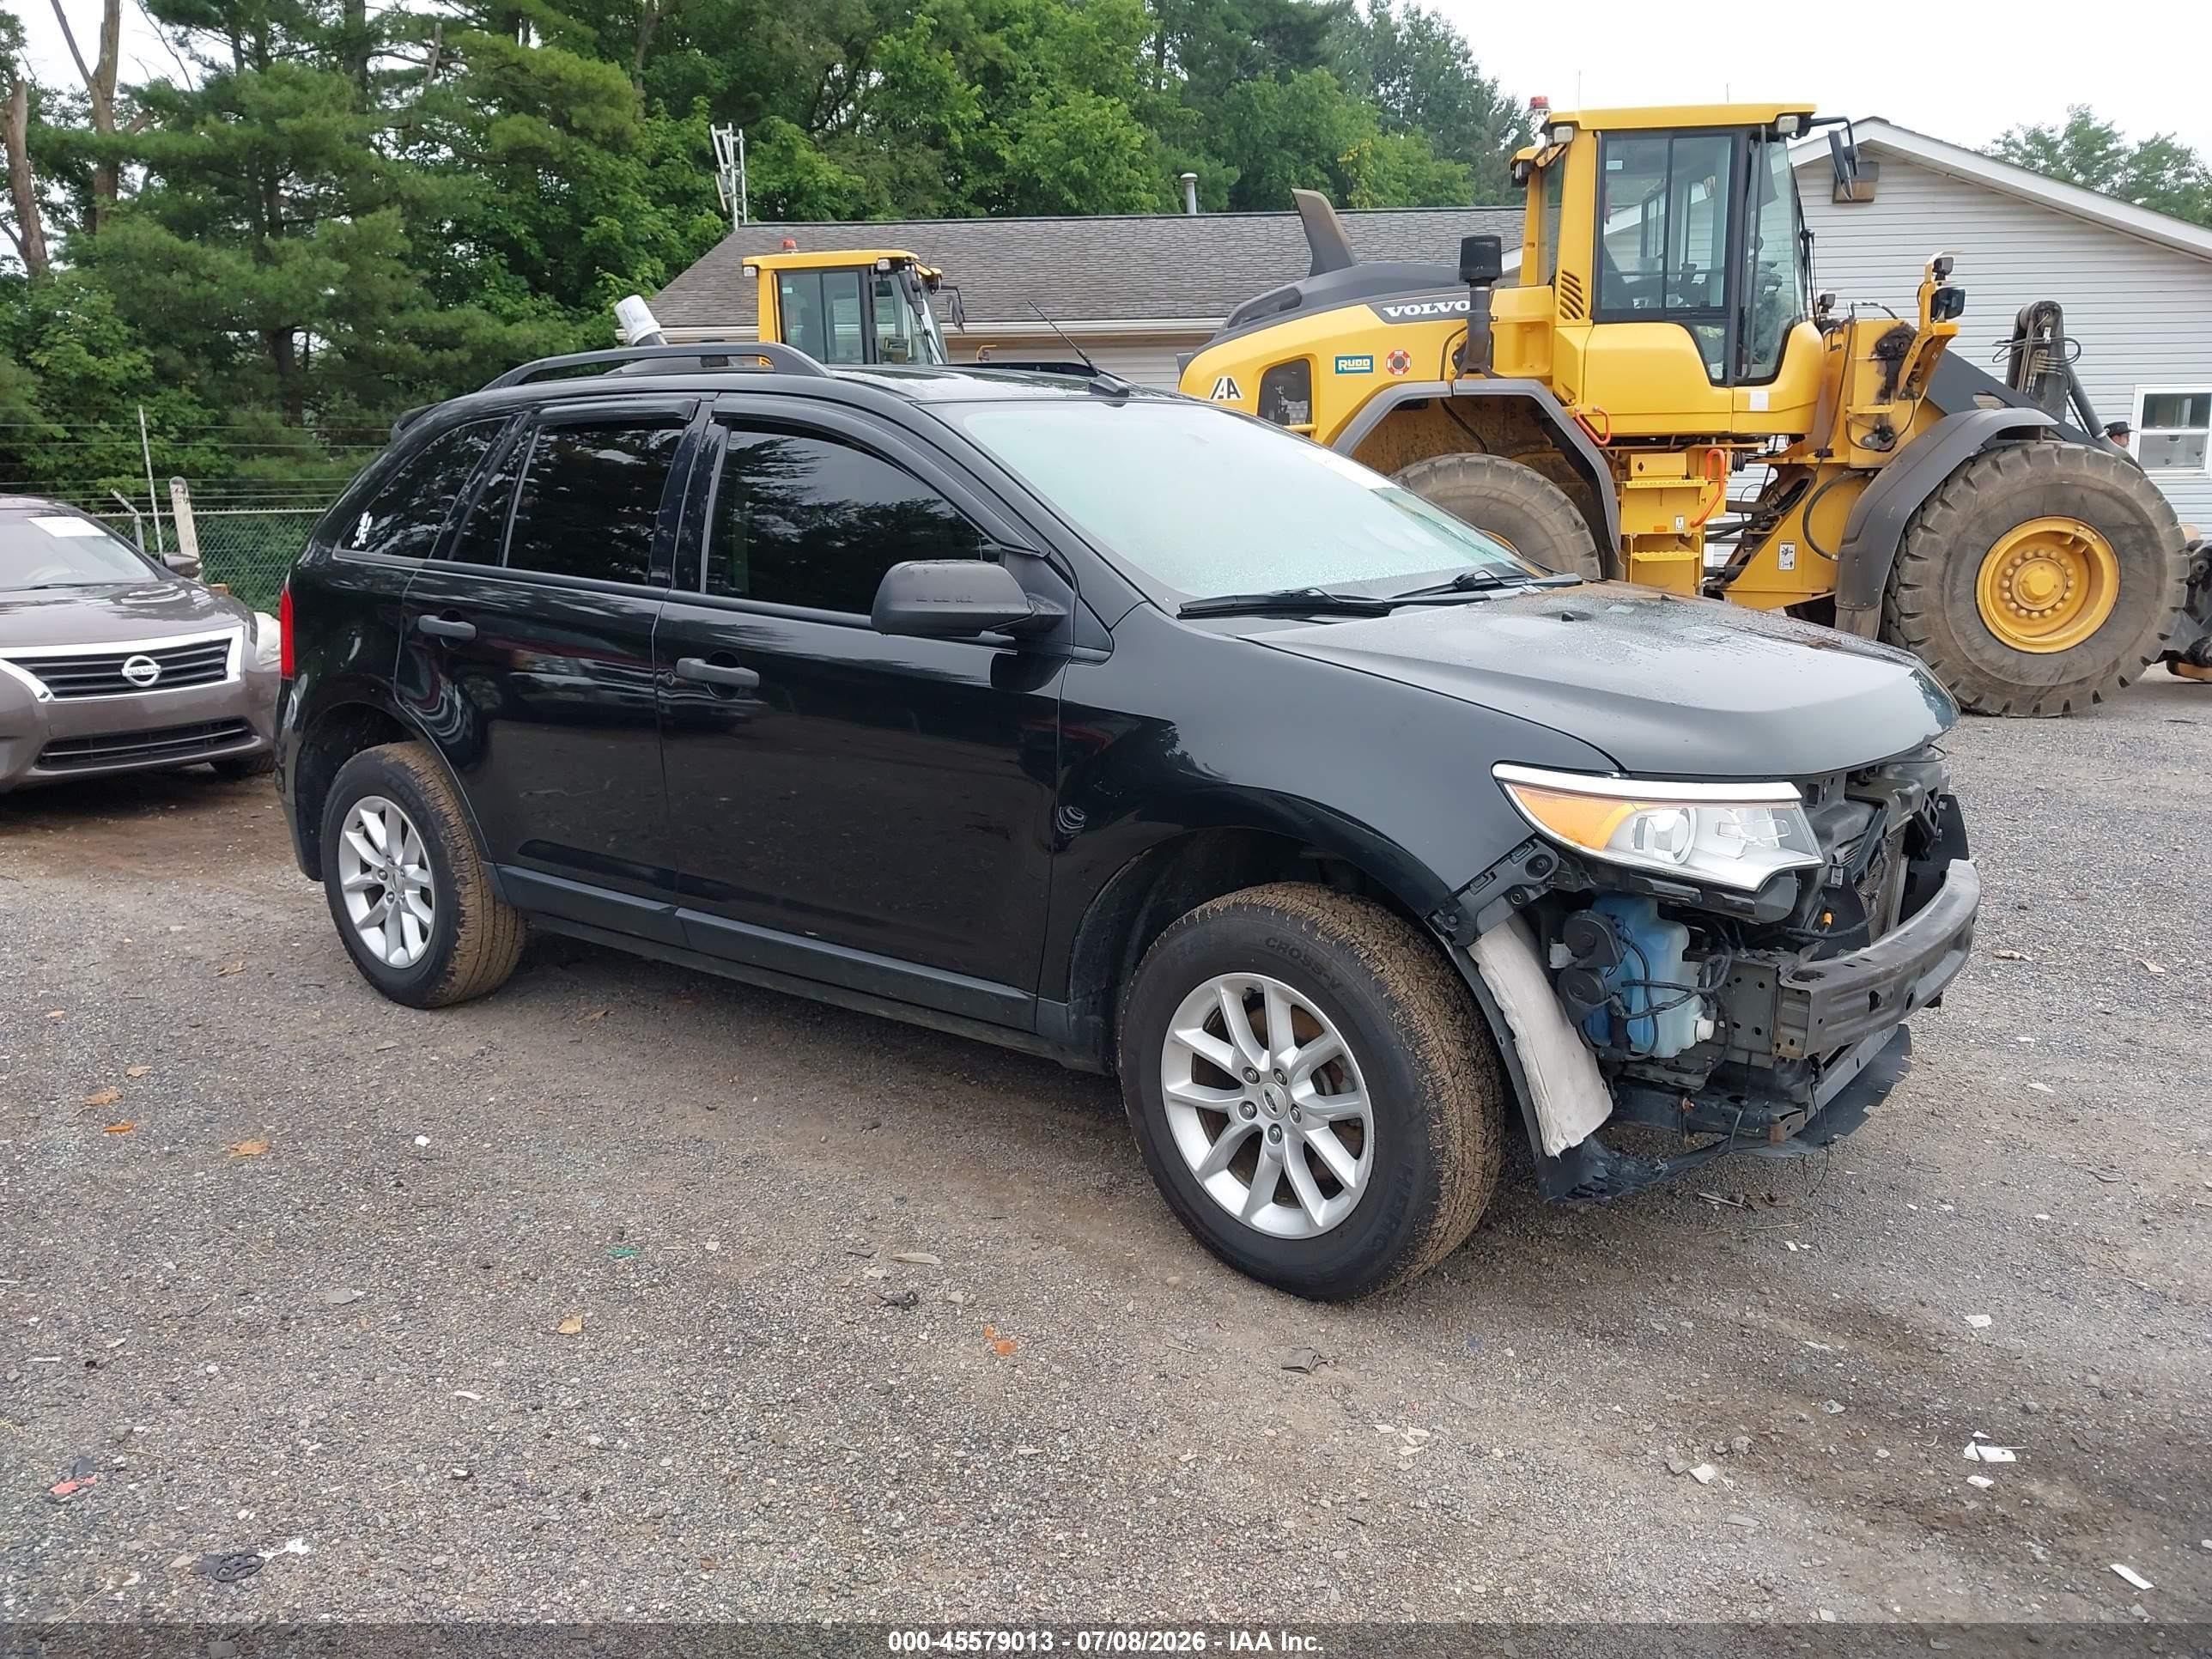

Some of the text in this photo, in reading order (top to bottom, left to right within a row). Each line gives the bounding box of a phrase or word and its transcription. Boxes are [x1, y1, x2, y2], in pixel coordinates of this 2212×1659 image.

[1382, 300, 1470, 317] VOLVO
[1338, 358, 1370, 371] RUDD
[127, 666, 158, 675] NISSAN
